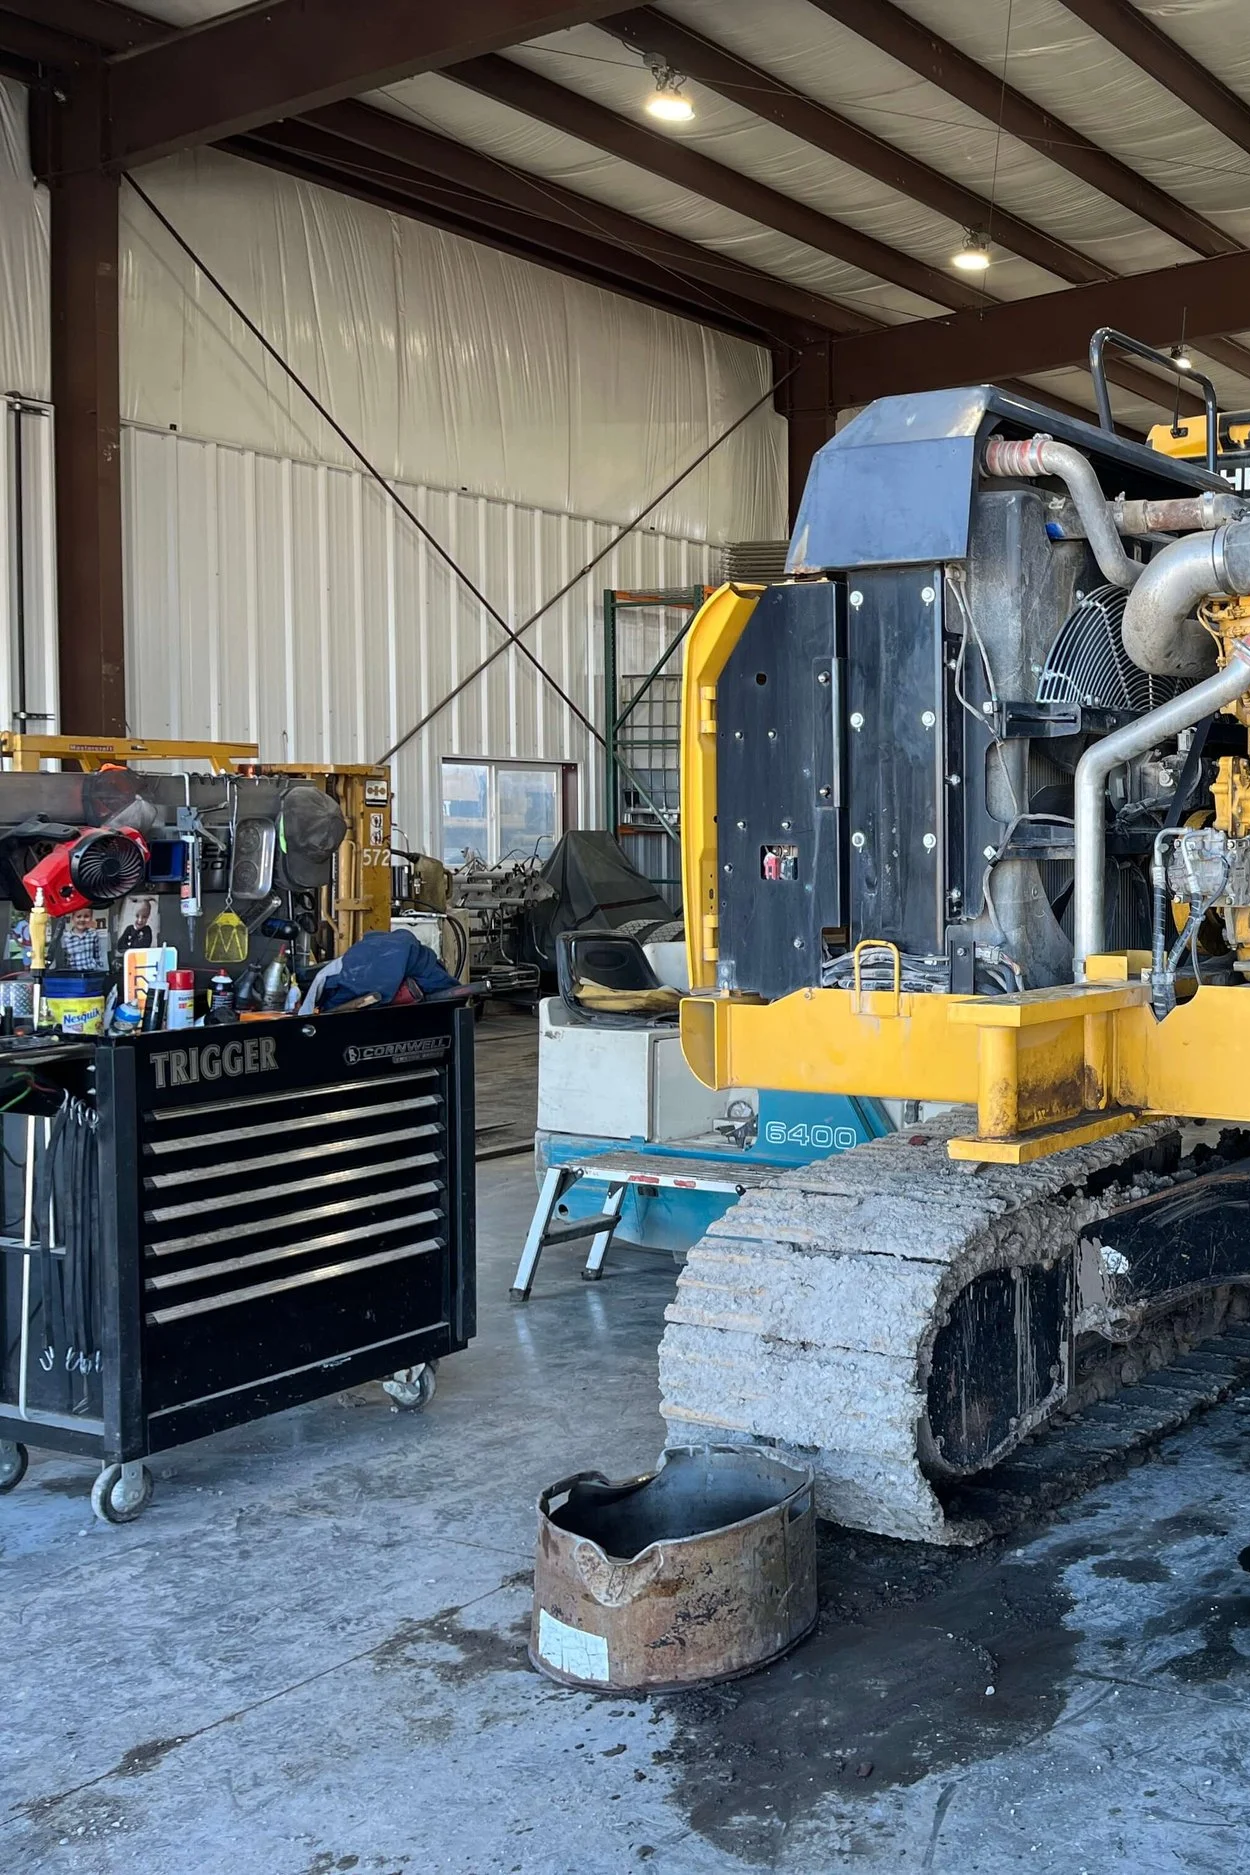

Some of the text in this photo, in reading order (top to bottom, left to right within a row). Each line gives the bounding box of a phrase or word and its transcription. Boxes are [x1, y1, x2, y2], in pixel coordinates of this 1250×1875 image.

[363, 848, 391, 866] 572
[63, 1008, 100, 1024] Nesquik
[363, 1038, 446, 1058] CORNWELL
[150, 1036, 279, 1089] TRIGGER
[765, 1120, 857, 1150] 6400
